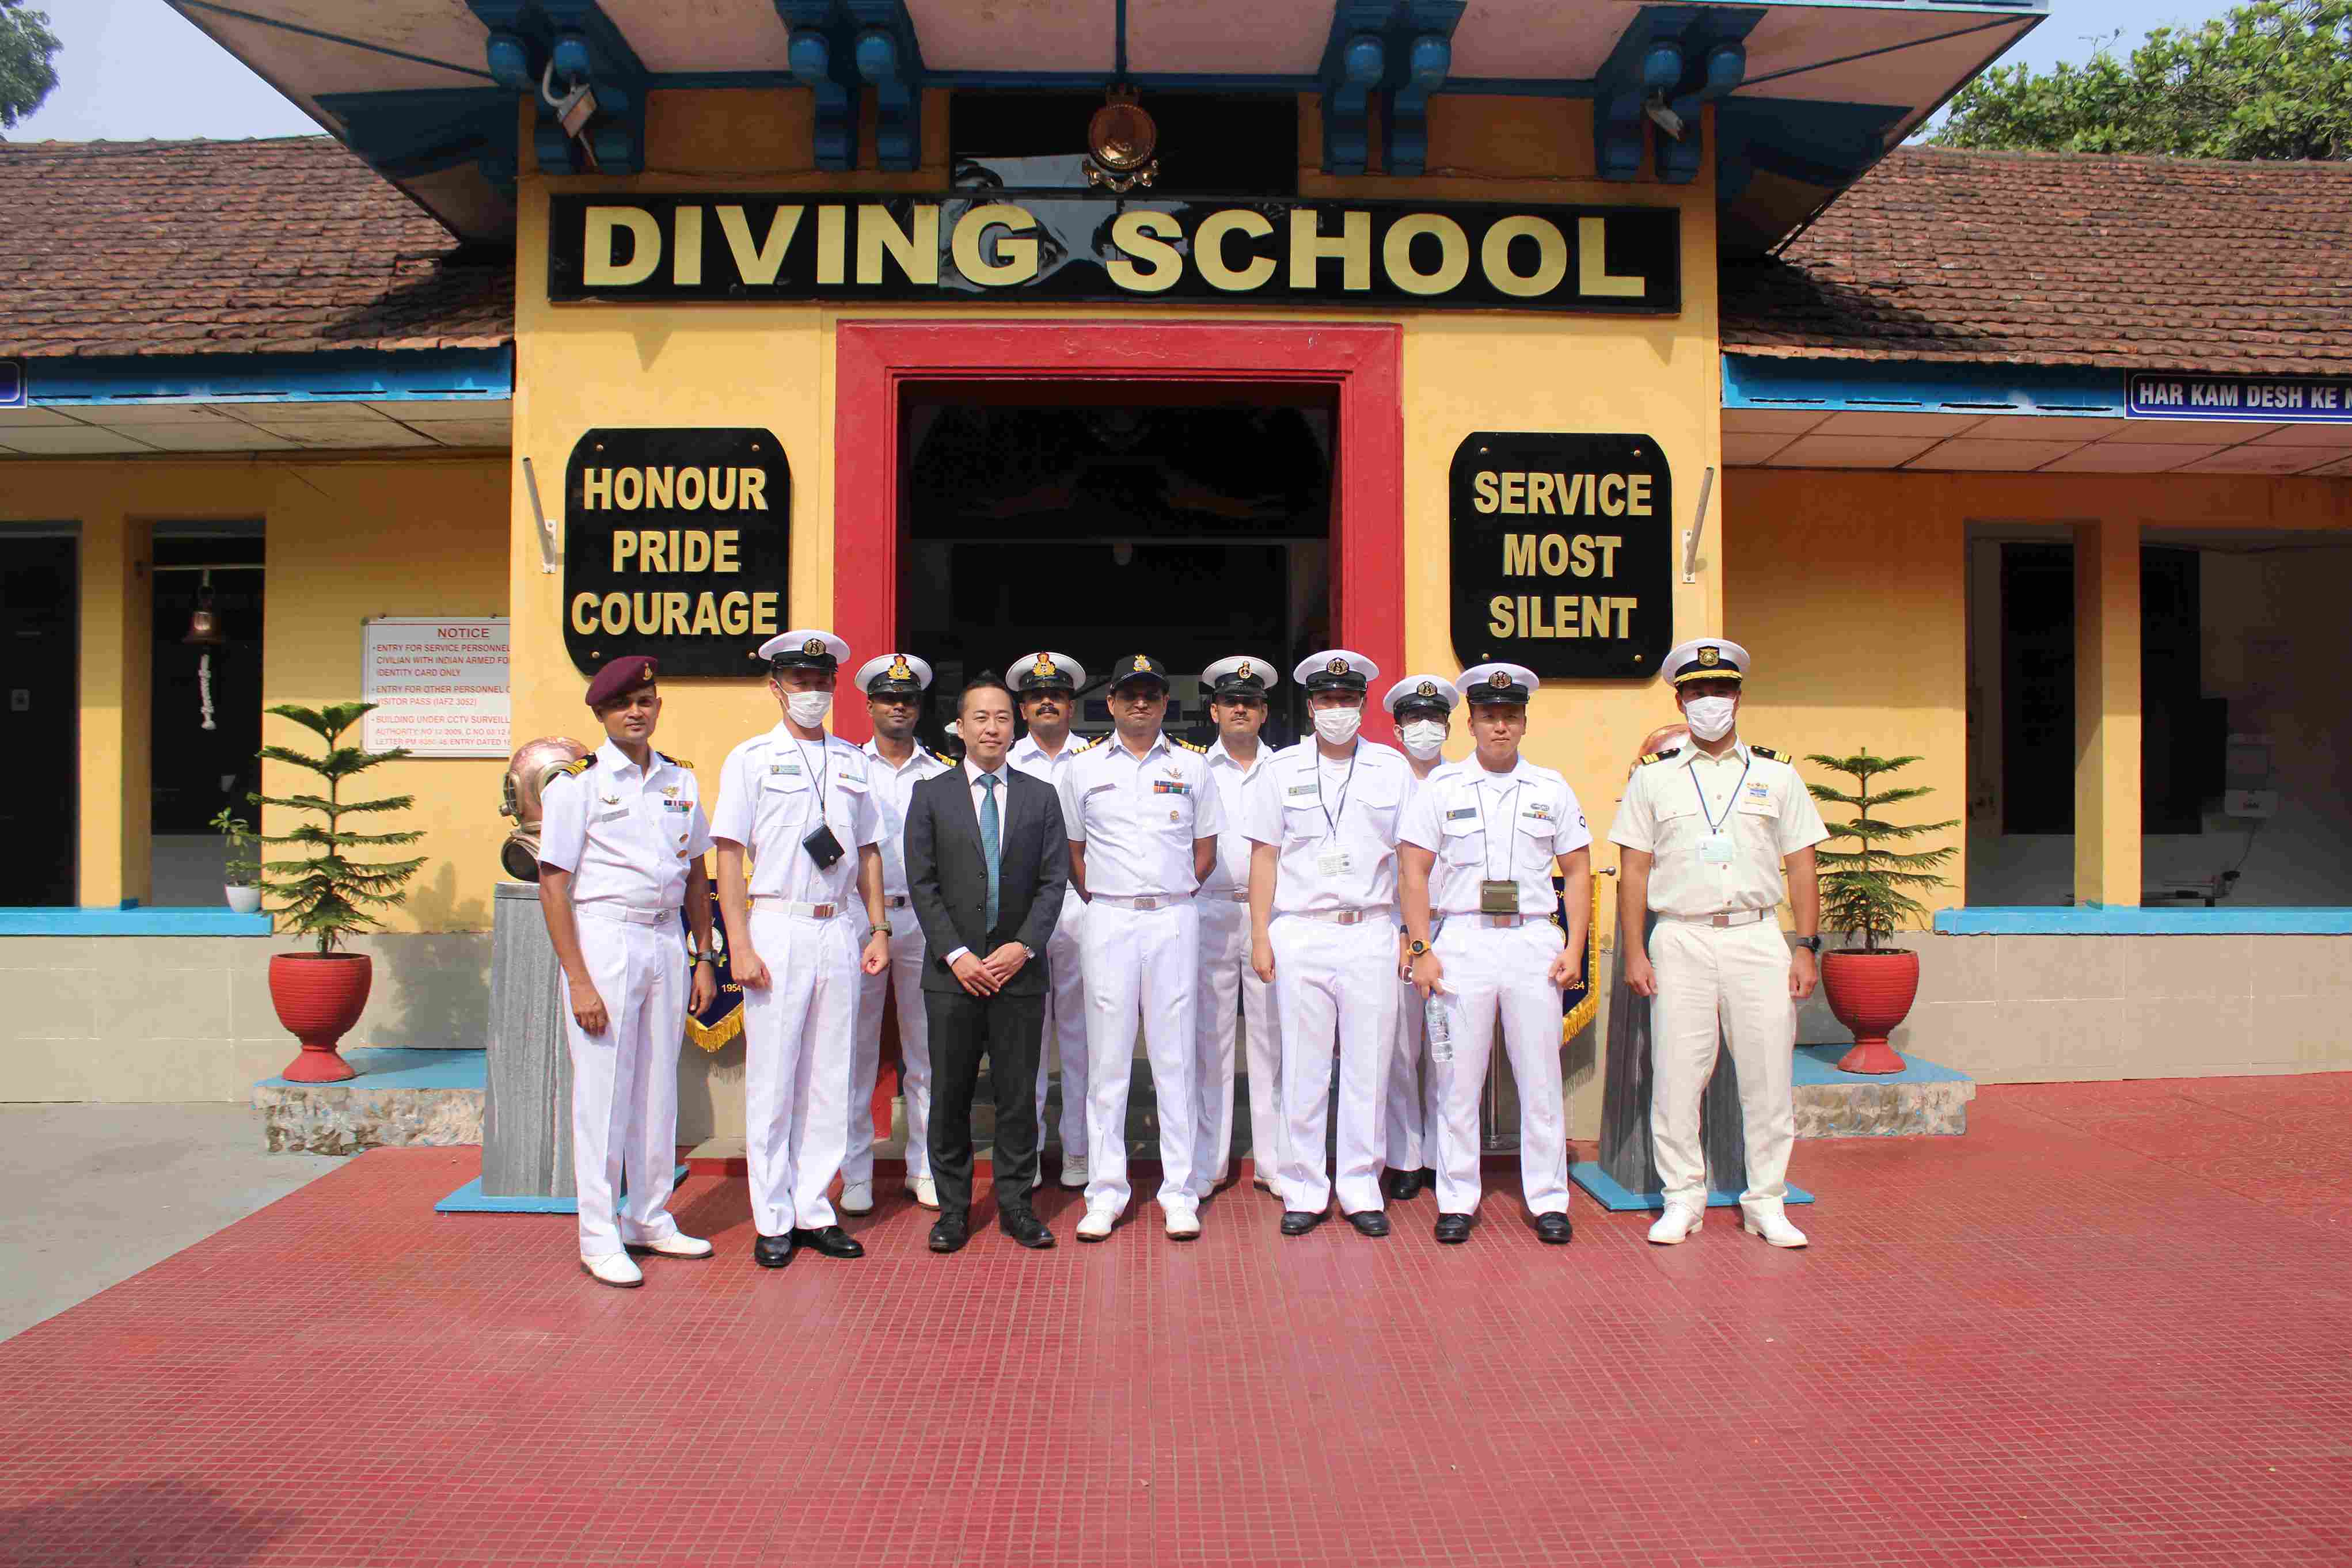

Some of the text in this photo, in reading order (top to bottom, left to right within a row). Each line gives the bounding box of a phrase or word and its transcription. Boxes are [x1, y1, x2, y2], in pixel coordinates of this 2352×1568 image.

[583, 204, 1646, 298] DIVING SCHOOL
[2139, 382, 2184, 405] HAR
[2190, 383, 2239, 407] KAM
[2247, 385, 2303, 409] DESH
[2311, 386, 2337, 409] KE
[584, 466, 768, 511] HONOUR
[1473, 471, 1652, 516] SERVICE
[613, 530, 741, 573] PRIDE
[1503, 534, 1622, 577] MOST
[437, 628, 490, 638] NOTICE
[572, 591, 779, 635] COURAGE
[1489, 595, 1637, 639] SILENT
[721, 984, 742, 992] 1954
